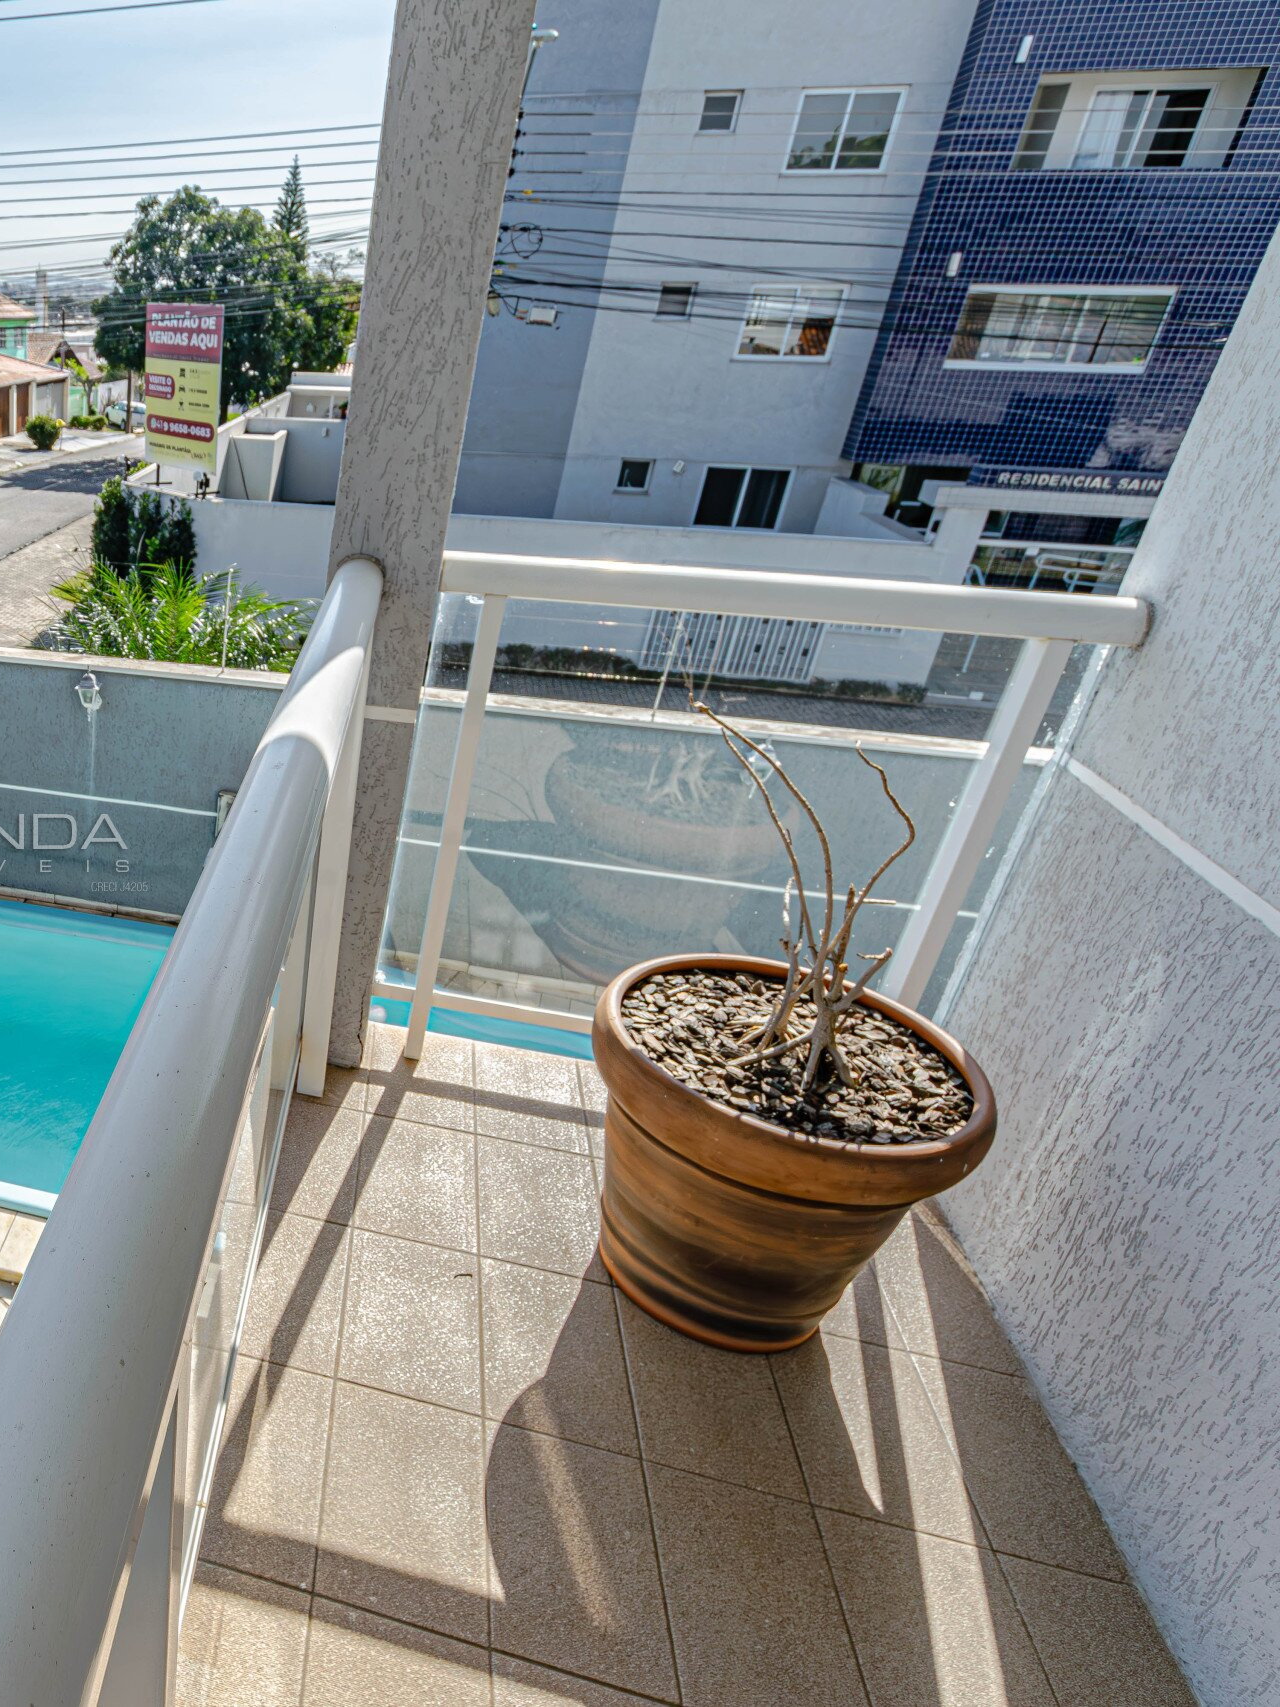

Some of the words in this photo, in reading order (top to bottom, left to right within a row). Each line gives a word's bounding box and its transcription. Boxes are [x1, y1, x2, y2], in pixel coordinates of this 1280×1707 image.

[152, 311, 199, 328] PLANTÃO
[201, 316, 216, 330] DE
[149, 330, 188, 346] VENDAS
[190, 333, 218, 350] AQUI
[998, 472, 1111, 489] RESIDENCIAL
